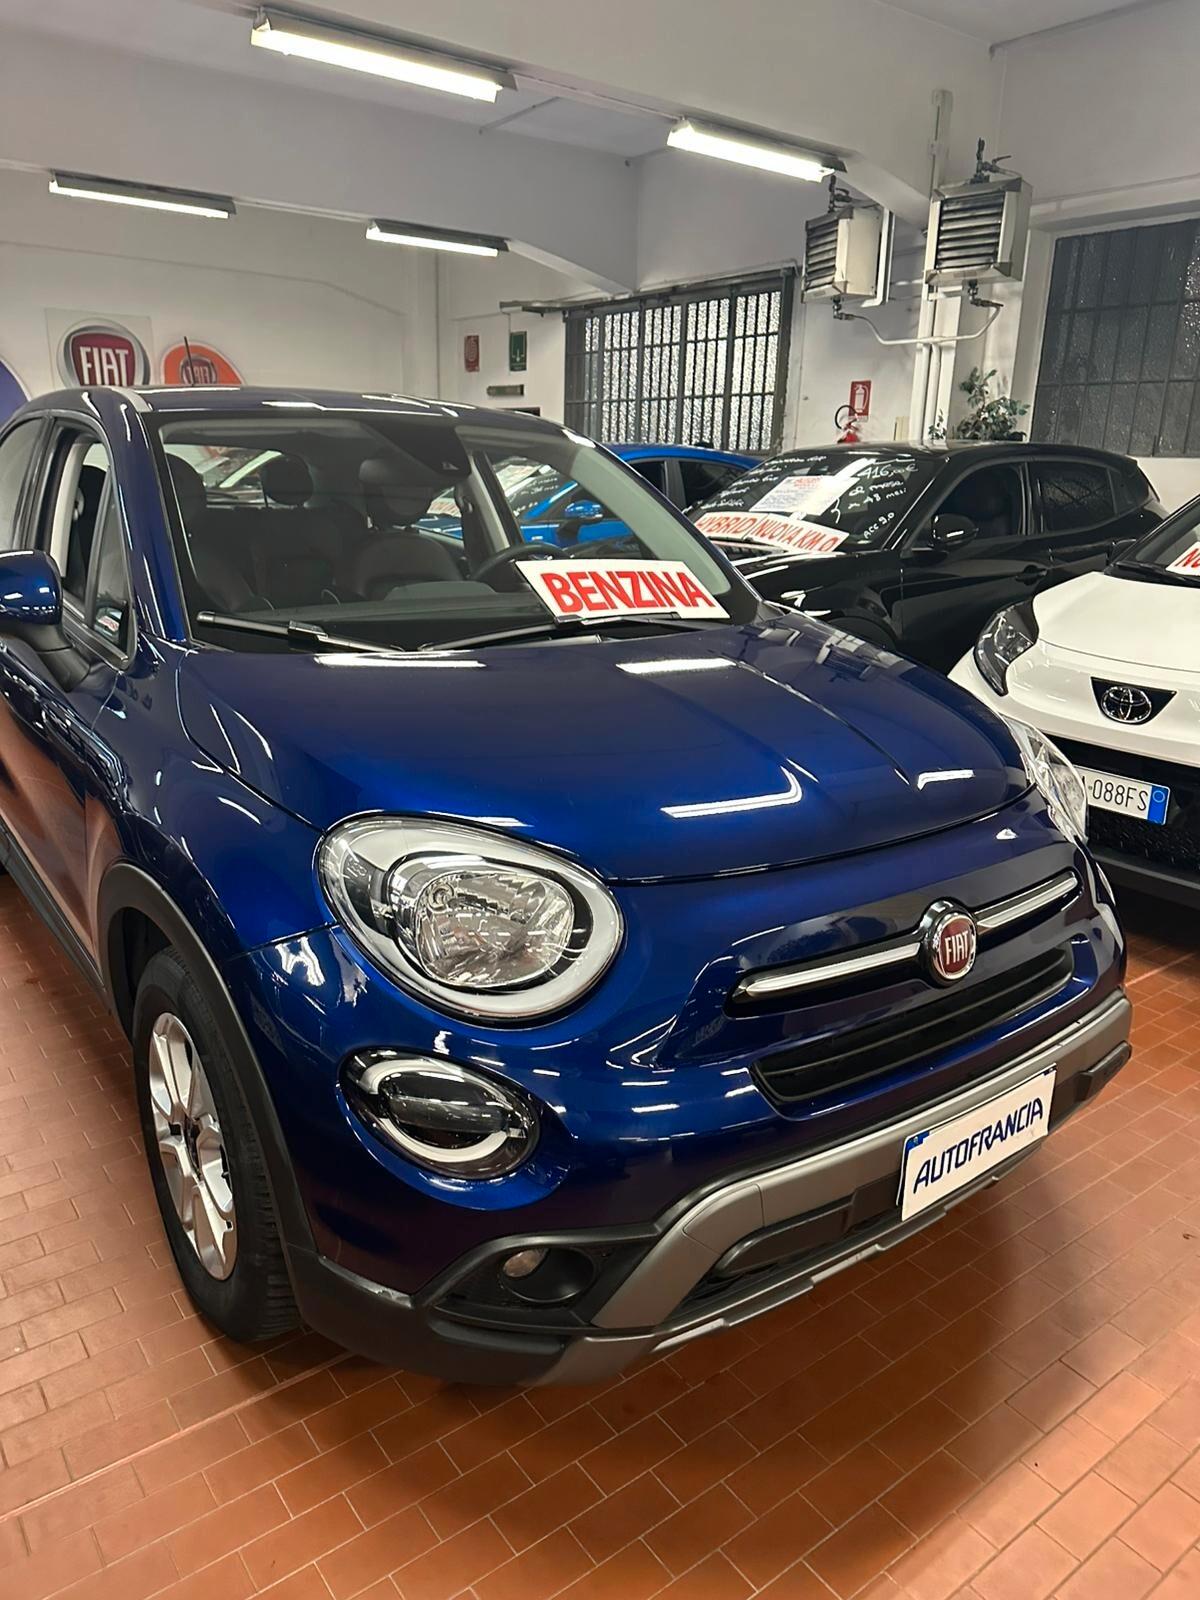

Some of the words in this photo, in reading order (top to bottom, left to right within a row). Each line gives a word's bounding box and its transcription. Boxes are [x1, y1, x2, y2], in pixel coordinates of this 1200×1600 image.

[79, 346, 129, 387] FIAT
[751, 519, 804, 545] NUOVA
[793, 529, 827, 551] KM
[540, 571, 716, 613] BENZINA
[944, 930, 969, 965] FIAT
[912, 1097, 1043, 1194] AUTOFRANCIA
